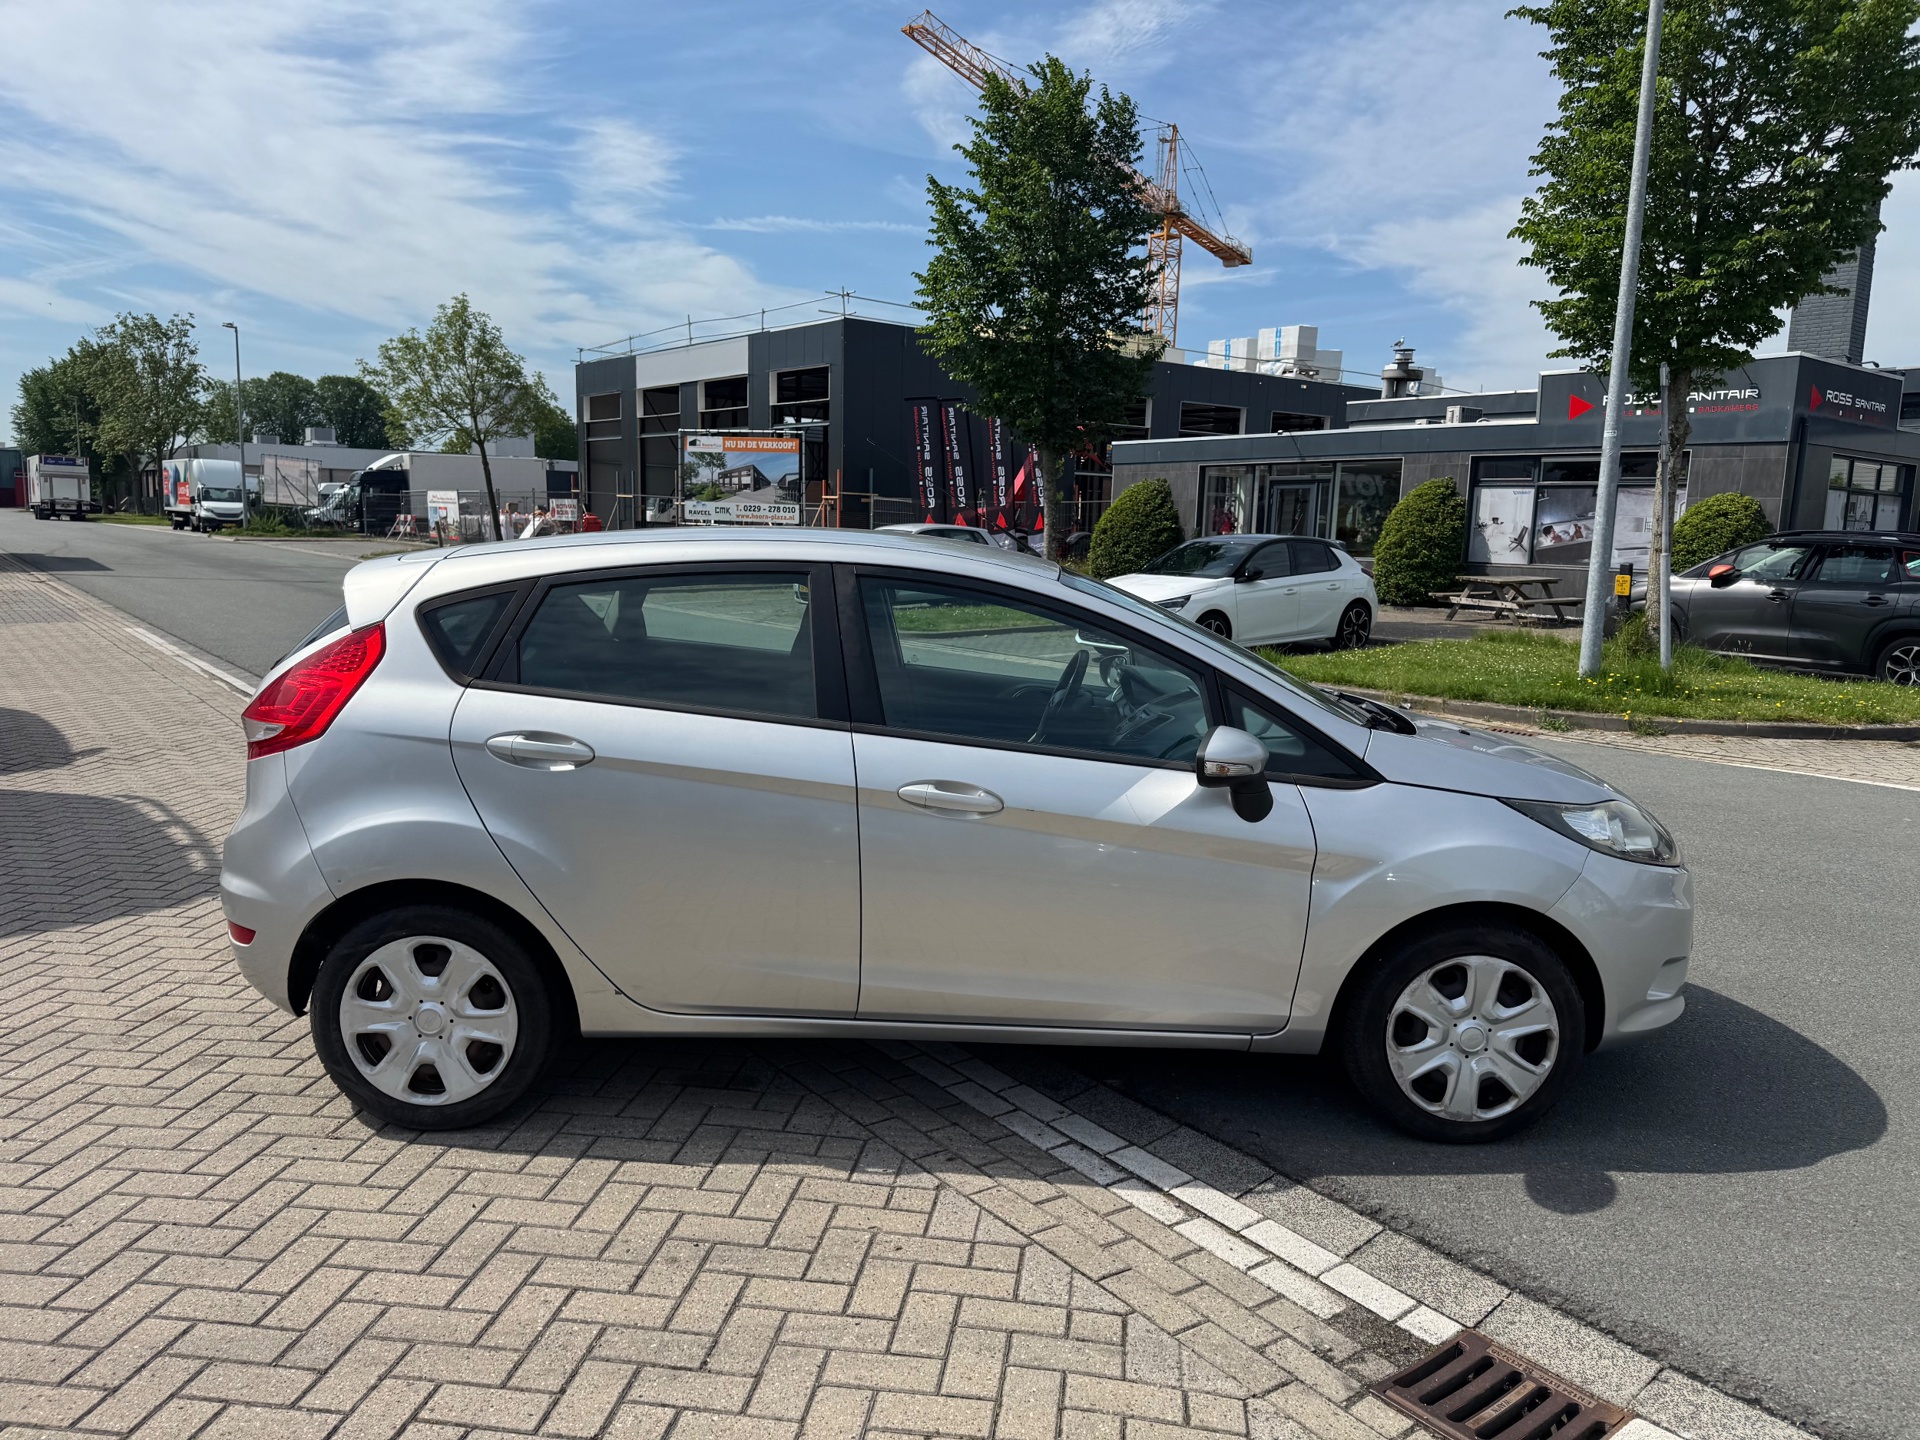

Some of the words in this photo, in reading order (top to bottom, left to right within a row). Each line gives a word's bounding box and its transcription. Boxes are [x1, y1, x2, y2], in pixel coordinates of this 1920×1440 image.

[1685, 389, 1759, 402] ANITAIR
[1826, 389, 1853, 406] ROSS
[1855, 398, 1887, 413] SANITAIR
[1698, 404, 1759, 414] BADKAMERS
[758, 442, 796, 450] VERKOOP!
